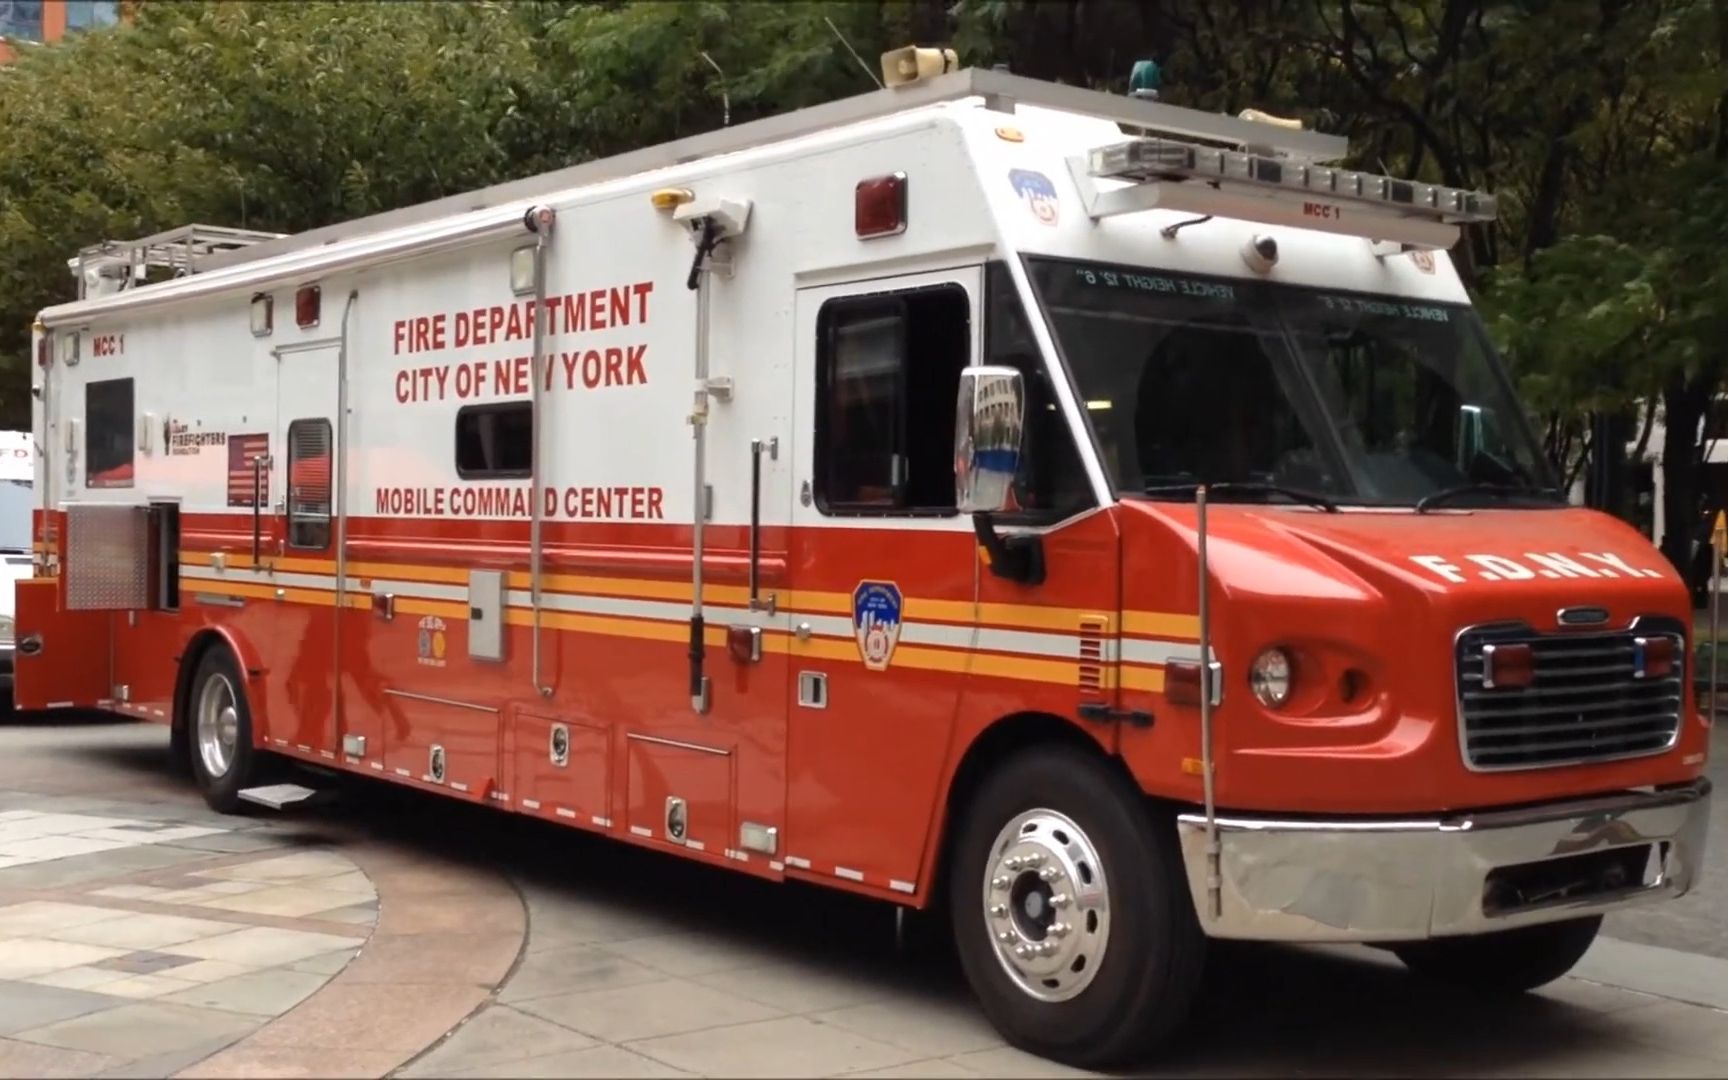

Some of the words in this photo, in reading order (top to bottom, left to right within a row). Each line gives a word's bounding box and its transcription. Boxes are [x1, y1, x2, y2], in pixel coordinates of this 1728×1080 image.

[1303, 201, 1330, 219] MCC
[1334, 206, 1341, 221] 1
[393, 313, 447, 356] FIRE
[454, 281, 654, 348] DEPARTMENT
[93, 335, 116, 357] MCC
[119, 333, 125, 355] 1
[395, 364, 450, 404] CITY
[455, 361, 488, 400] OF
[561, 343, 648, 391] YORK
[375, 487, 445, 516] MOBILE
[564, 486, 664, 520] CENTER
